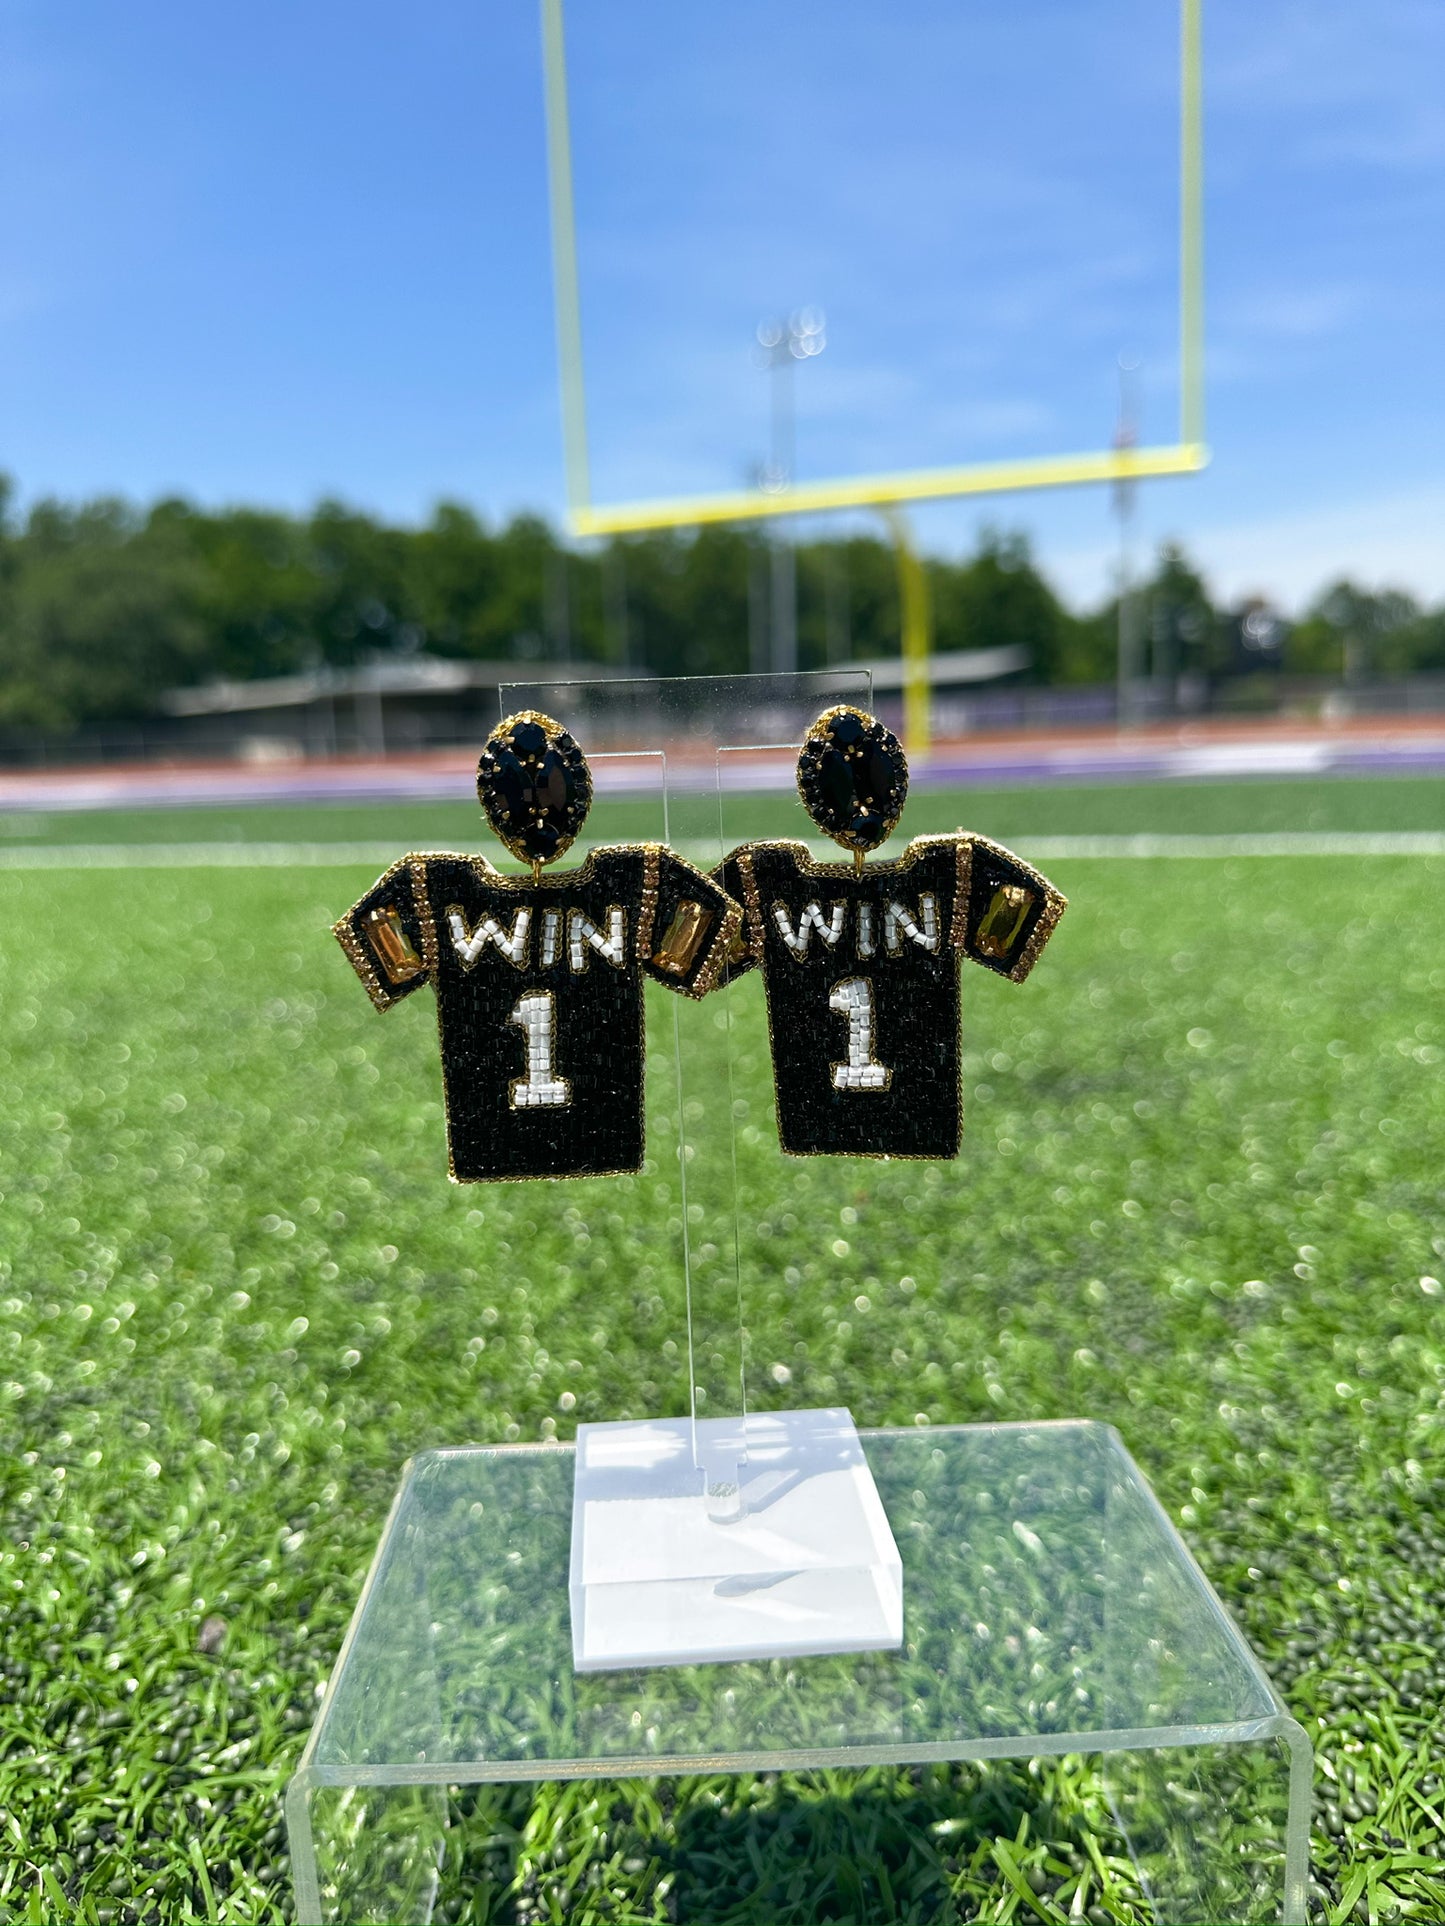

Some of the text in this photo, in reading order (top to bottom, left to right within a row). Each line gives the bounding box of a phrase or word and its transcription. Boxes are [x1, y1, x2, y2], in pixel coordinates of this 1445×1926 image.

[447, 907, 626, 971] WIN
[773, 894, 939, 958] WIN
[509, 992, 570, 1107] 1
[829, 978, 891, 1090] 1
